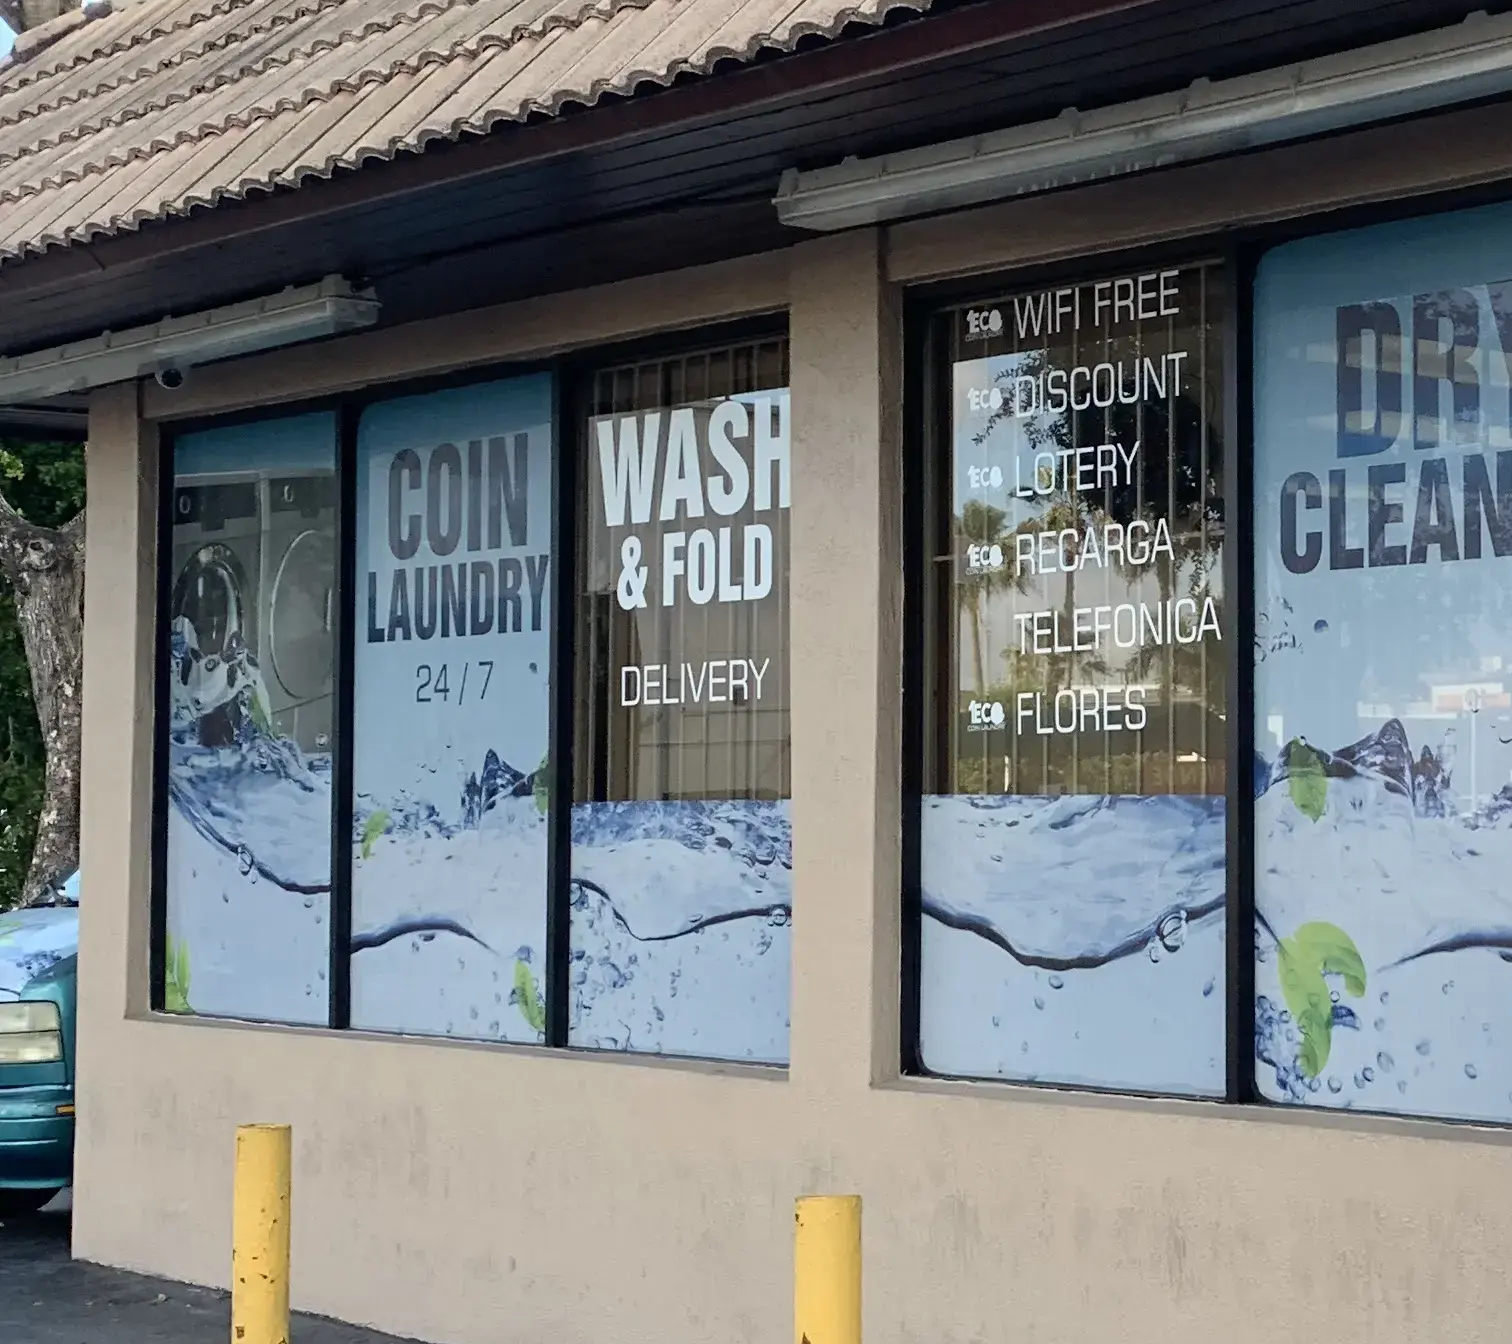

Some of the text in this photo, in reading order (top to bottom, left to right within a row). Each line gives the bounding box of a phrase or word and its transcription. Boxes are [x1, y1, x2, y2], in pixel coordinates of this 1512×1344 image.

[1014, 269, 1180, 339] WIFI FREE
[1015, 351, 1188, 419] DISCOUNT
[597, 394, 791, 527] WASH
[1015, 440, 1141, 498] LOTERY
[388, 433, 530, 560] COIN
[616, 523, 773, 611] & FOLD
[1016, 517, 1175, 577] RECARGA
[367, 554, 549, 643] LAUNDRY
[1013, 596, 1222, 655] TELEFONICA
[620, 657, 771, 708] DELIVERY
[1016, 685, 1147, 736] FLORES
